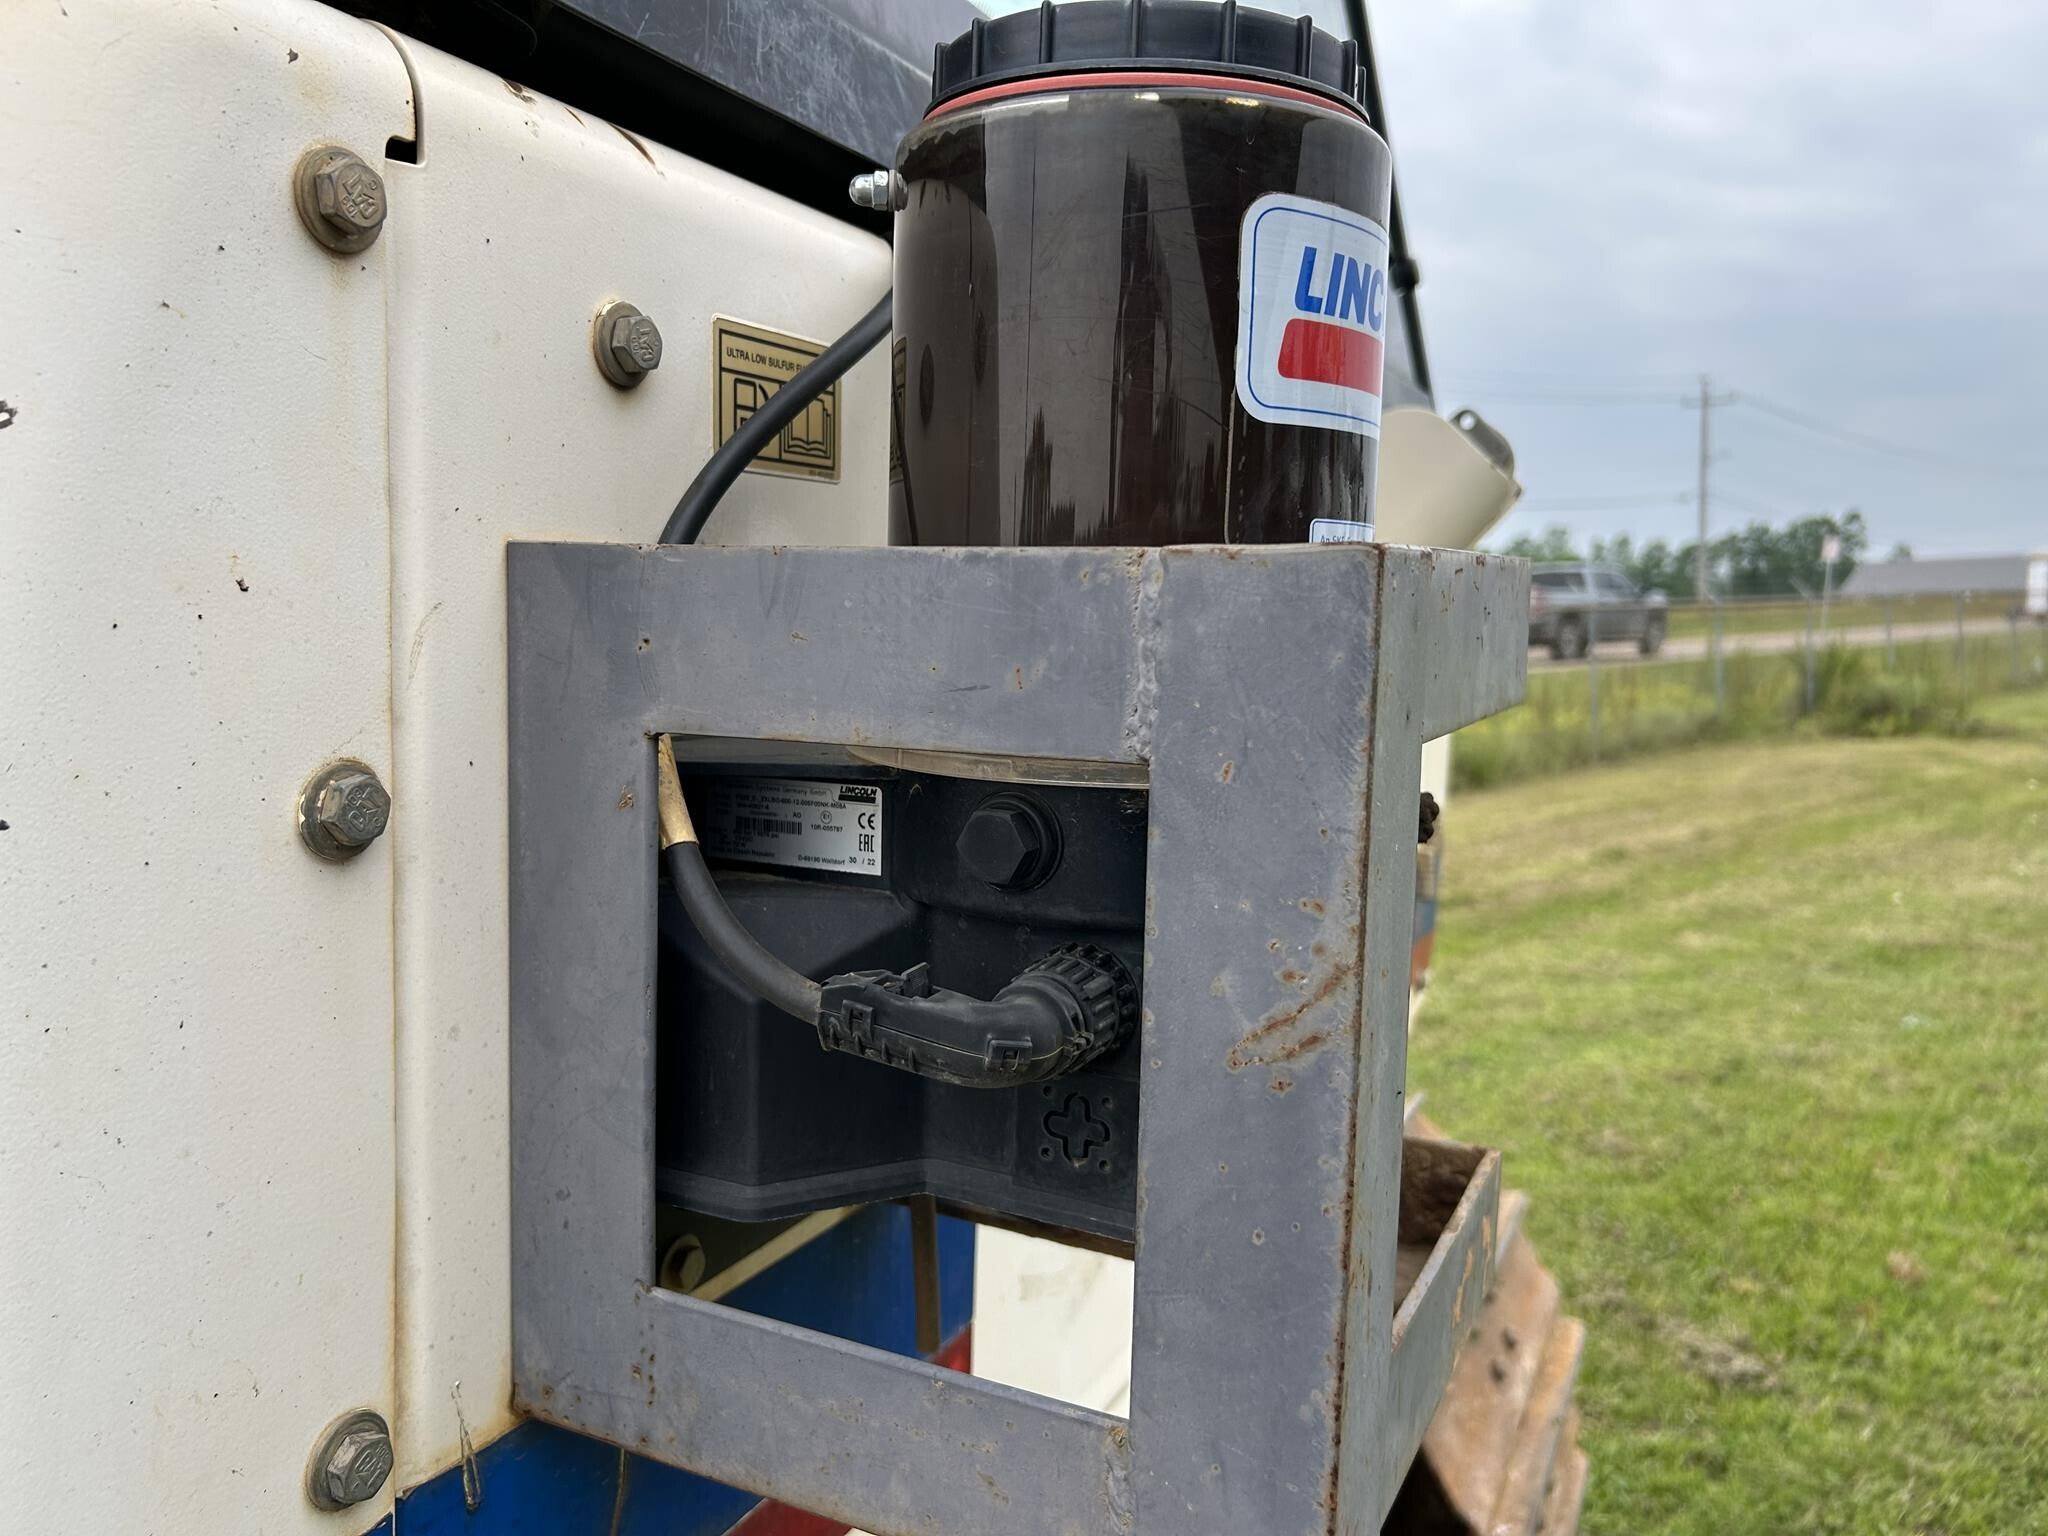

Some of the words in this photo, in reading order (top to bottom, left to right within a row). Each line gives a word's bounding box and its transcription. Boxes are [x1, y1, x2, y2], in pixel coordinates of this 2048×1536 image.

[726, 347, 750, 362] ULTRA
[751, 352, 767, 366] LOW
[768, 356, 795, 370] SULFUR
[840, 785, 878, 797] LINCOLN
[848, 855, 857, 864] 30
[867, 857, 876, 866] 22
